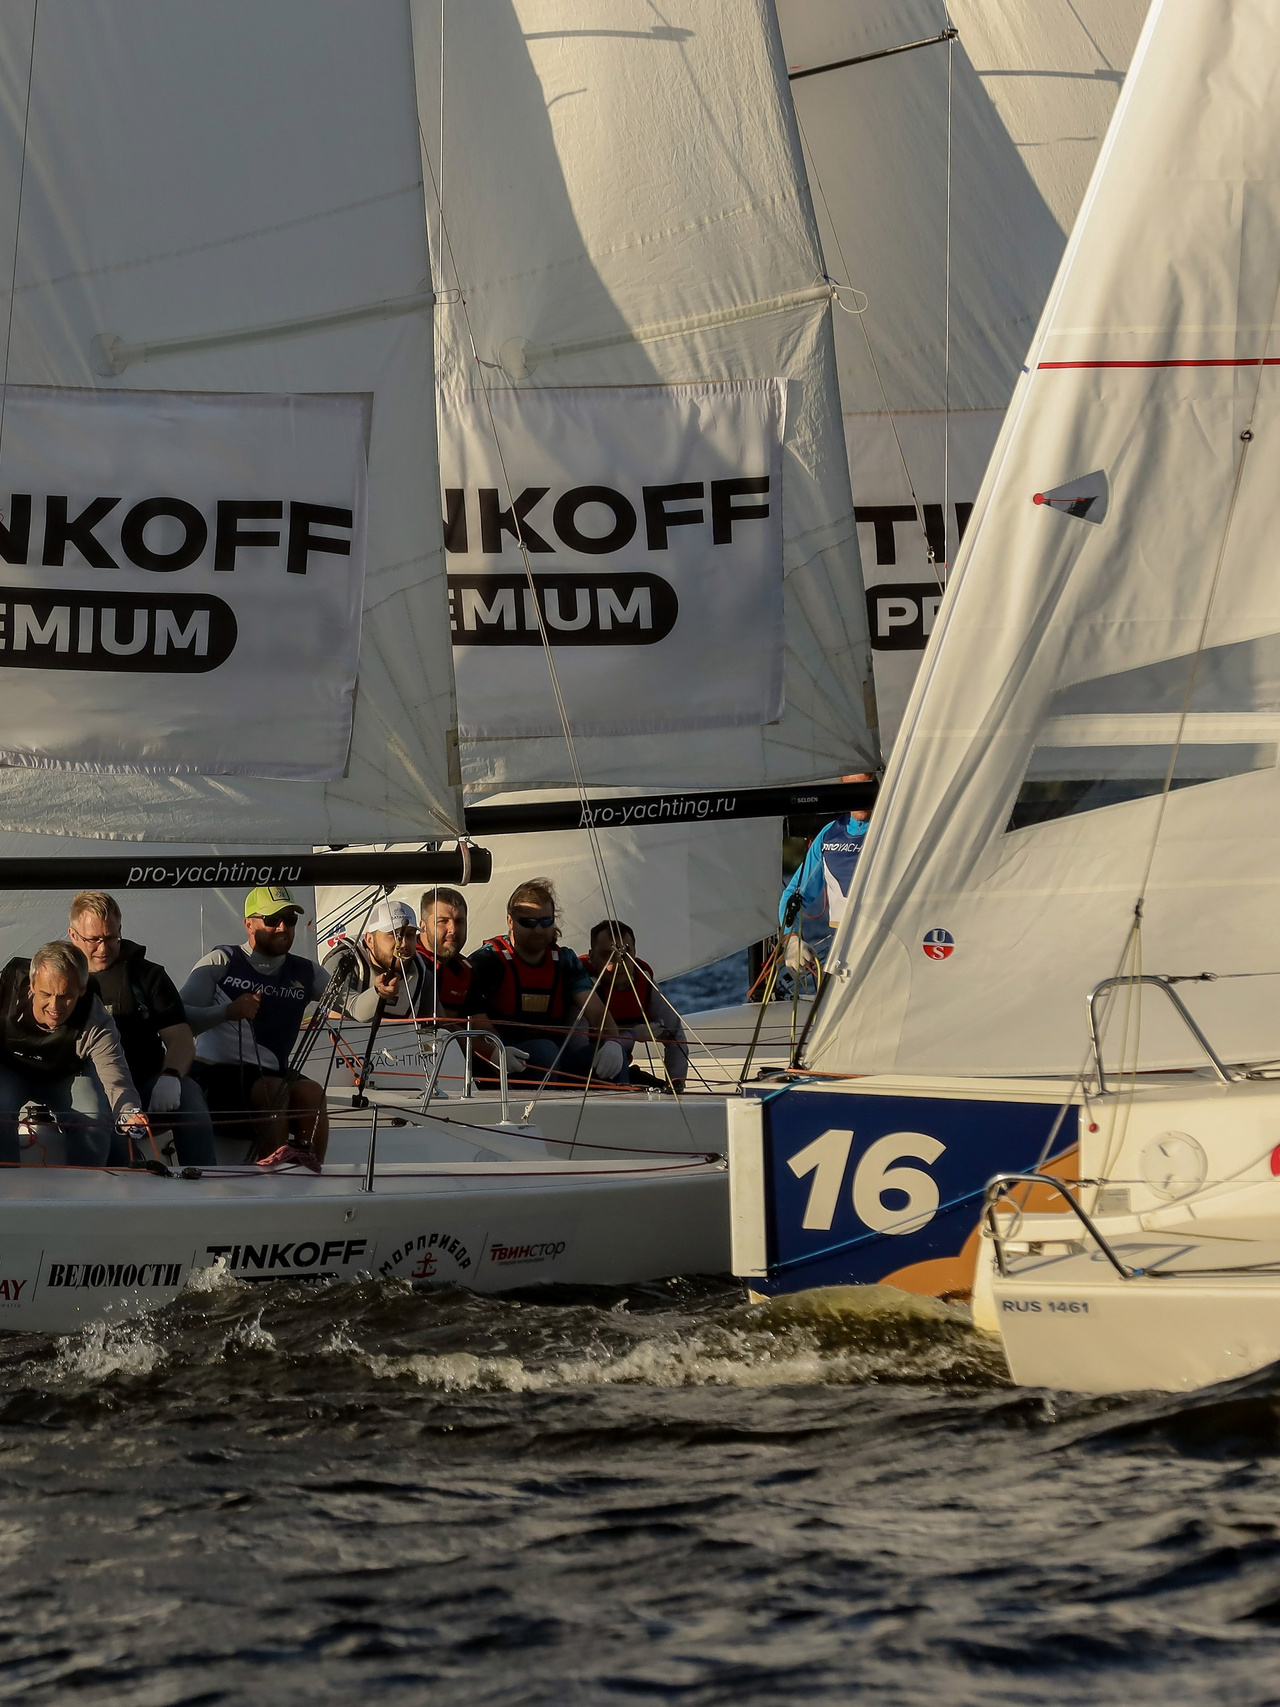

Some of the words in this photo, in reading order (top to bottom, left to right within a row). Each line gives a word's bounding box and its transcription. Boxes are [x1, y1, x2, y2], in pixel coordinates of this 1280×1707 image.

[854, 502, 974, 565] TI
[448, 587, 653, 632] MIUM
[578, 797, 737, 828] pro-yachting.ru
[125, 861, 302, 886] pro-yachting.ru
[223, 975, 305, 1000] PROYACHTING
[786, 1128, 947, 1236] 16
[205, 1239, 368, 1271] TINKOFF
[378, 1233, 472, 1277] МОРПРИБОР
[47, 1263, 183, 1290] ВЕДОМОСТИ
[1002, 1300, 1043, 1313] RUS
[1048, 1301, 1090, 1314] 1461
